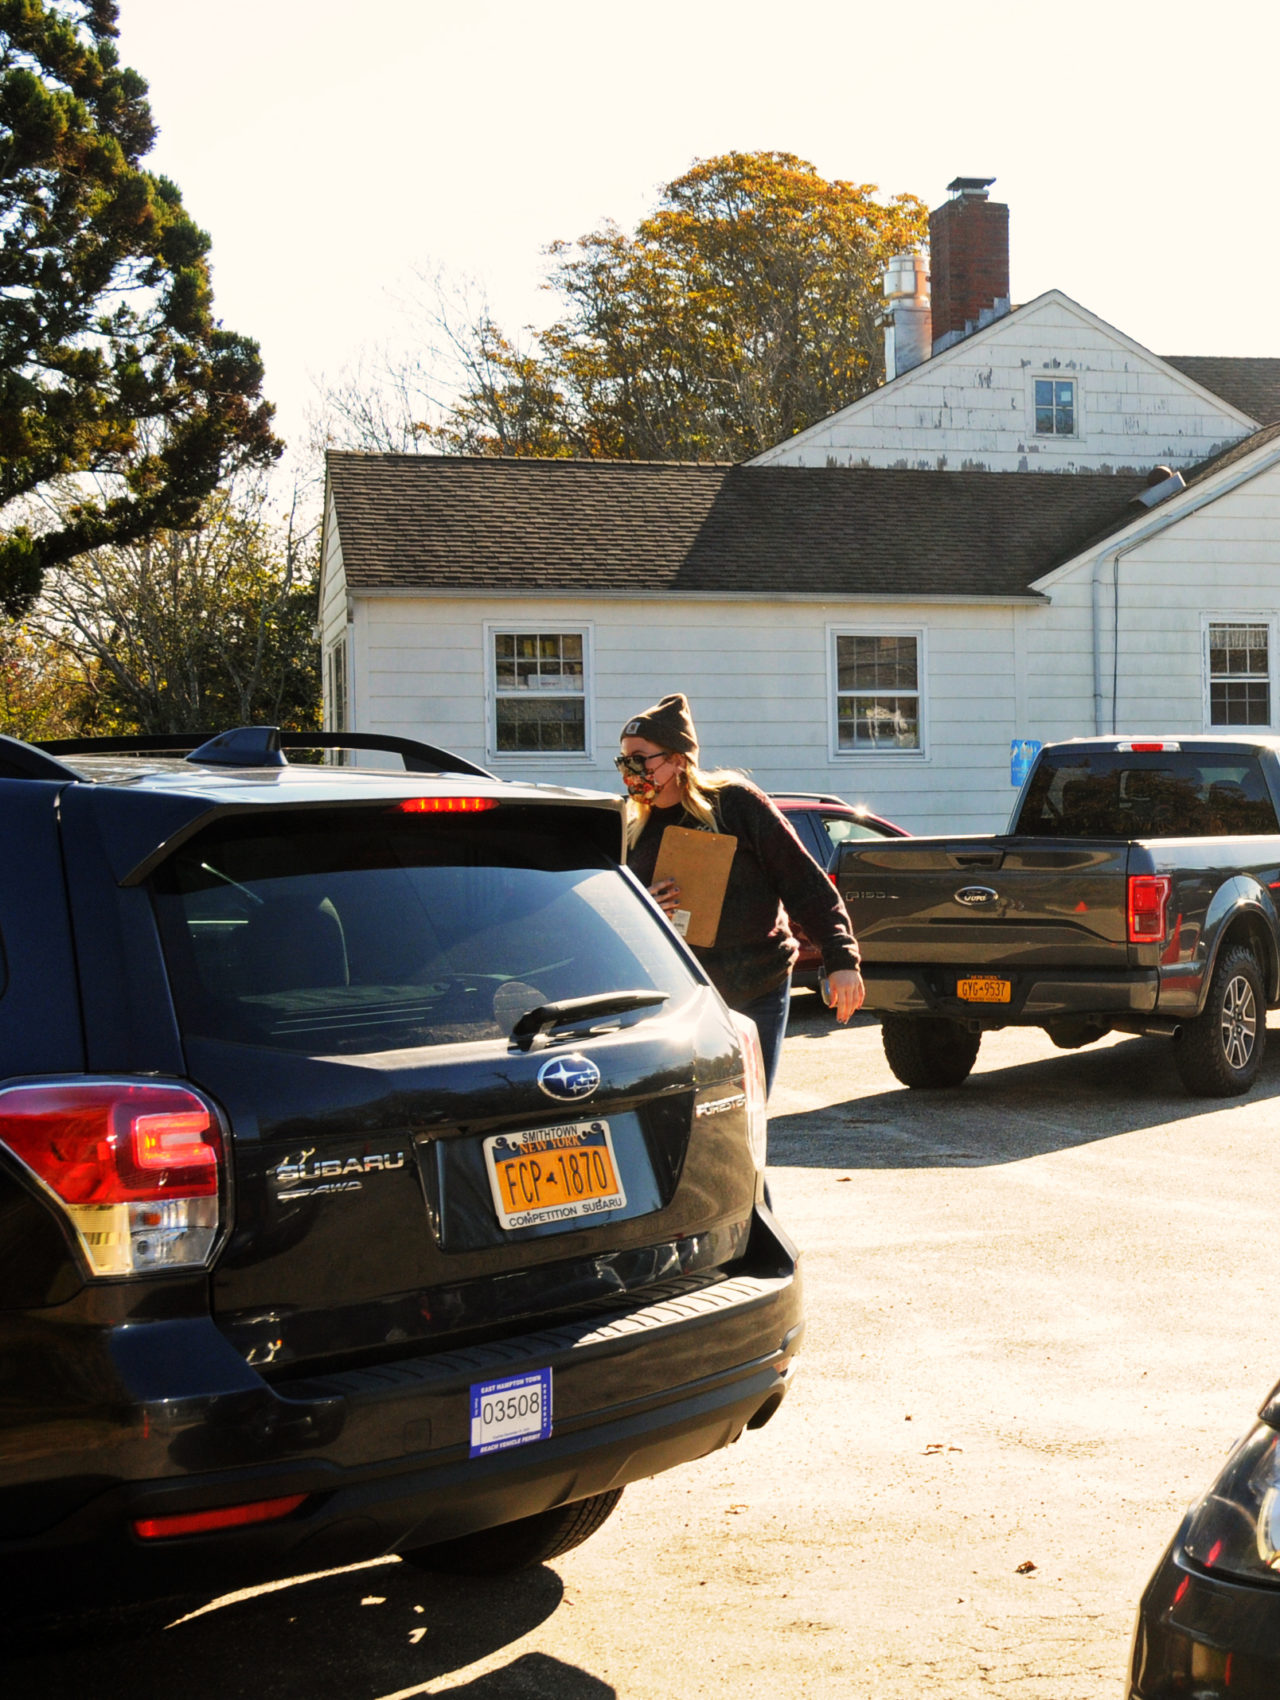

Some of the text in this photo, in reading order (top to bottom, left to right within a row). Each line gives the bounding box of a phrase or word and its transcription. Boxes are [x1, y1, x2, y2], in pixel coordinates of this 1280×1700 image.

[519, 1135, 582, 1155] NEW YORK
[521, 1125, 578, 1143] SMITHTOWN
[276, 1152, 404, 1180] SUBARU
[505, 1150, 608, 1206] FCP 1870
[509, 1198, 623, 1228] COMPETITION SUBARU
[481, 1375, 542, 1394] EAST HAMPTON TOWN
[482, 1391, 541, 1425] 03508
[480, 1443, 499, 1453] BEACH
